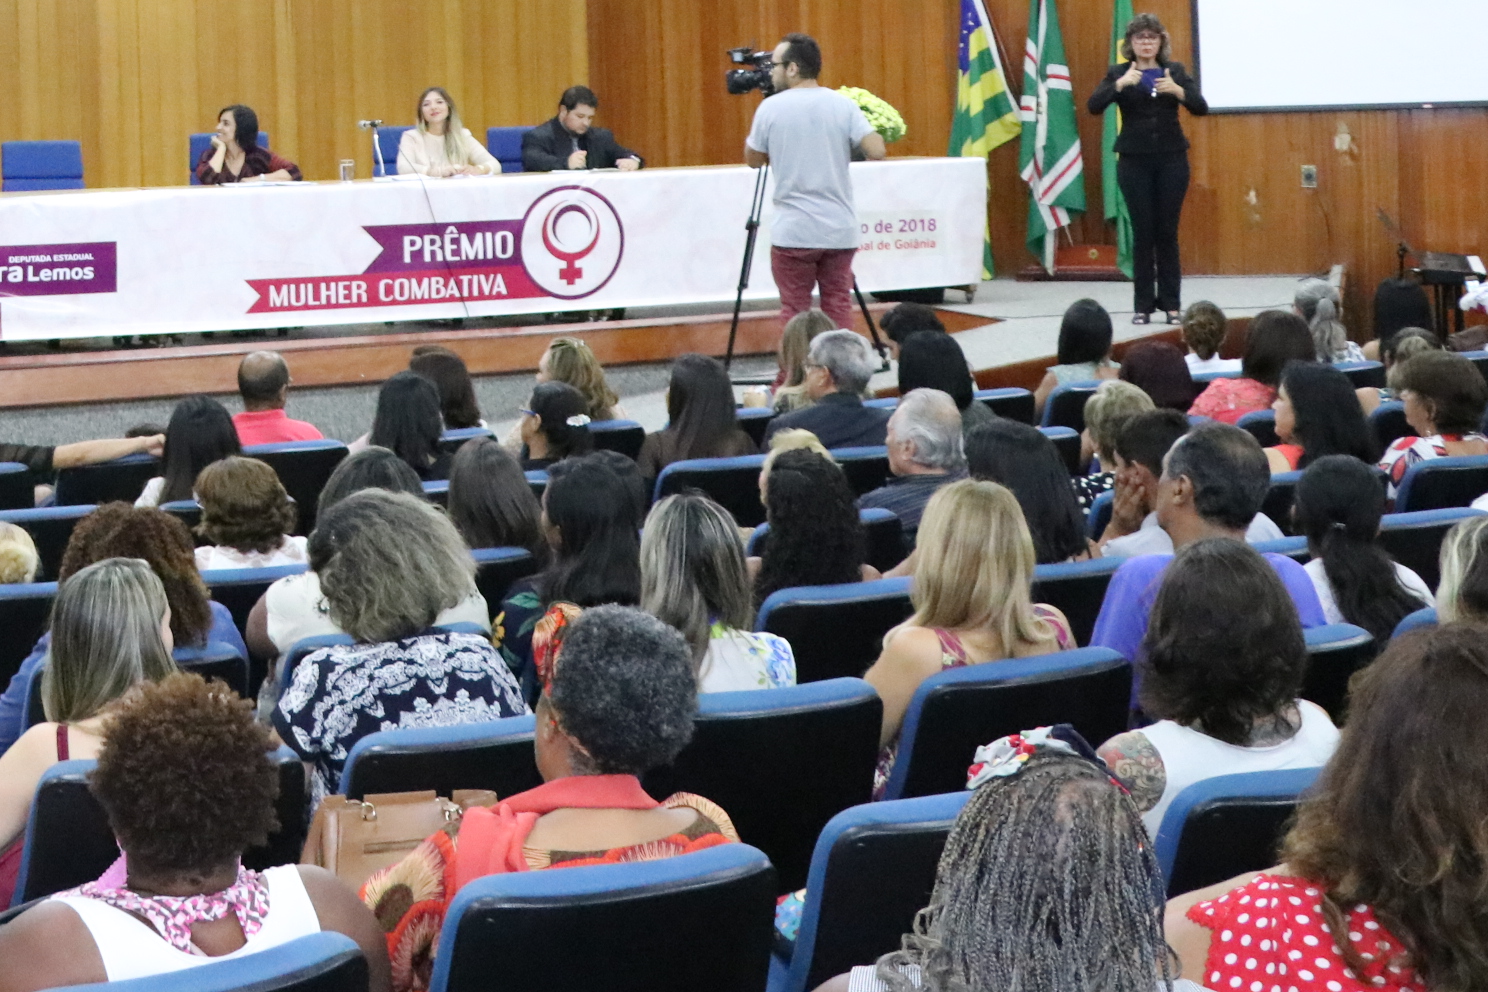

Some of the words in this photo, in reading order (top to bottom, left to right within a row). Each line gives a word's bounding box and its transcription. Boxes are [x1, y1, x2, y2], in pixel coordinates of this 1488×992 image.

[874, 219, 893, 234] de
[898, 218, 937, 233] 2018
[403, 226, 514, 264] PRÊMIO
[877, 240, 891, 250] de
[894, 239, 936, 249] Goiânia
[8, 255, 52, 264] DEPUTADA
[53, 253, 94, 262] ESTADUAL
[27, 265, 95, 282] Lemos
[269, 280, 368, 308] MULHER
[378, 273, 508, 303] COMBATIVA
